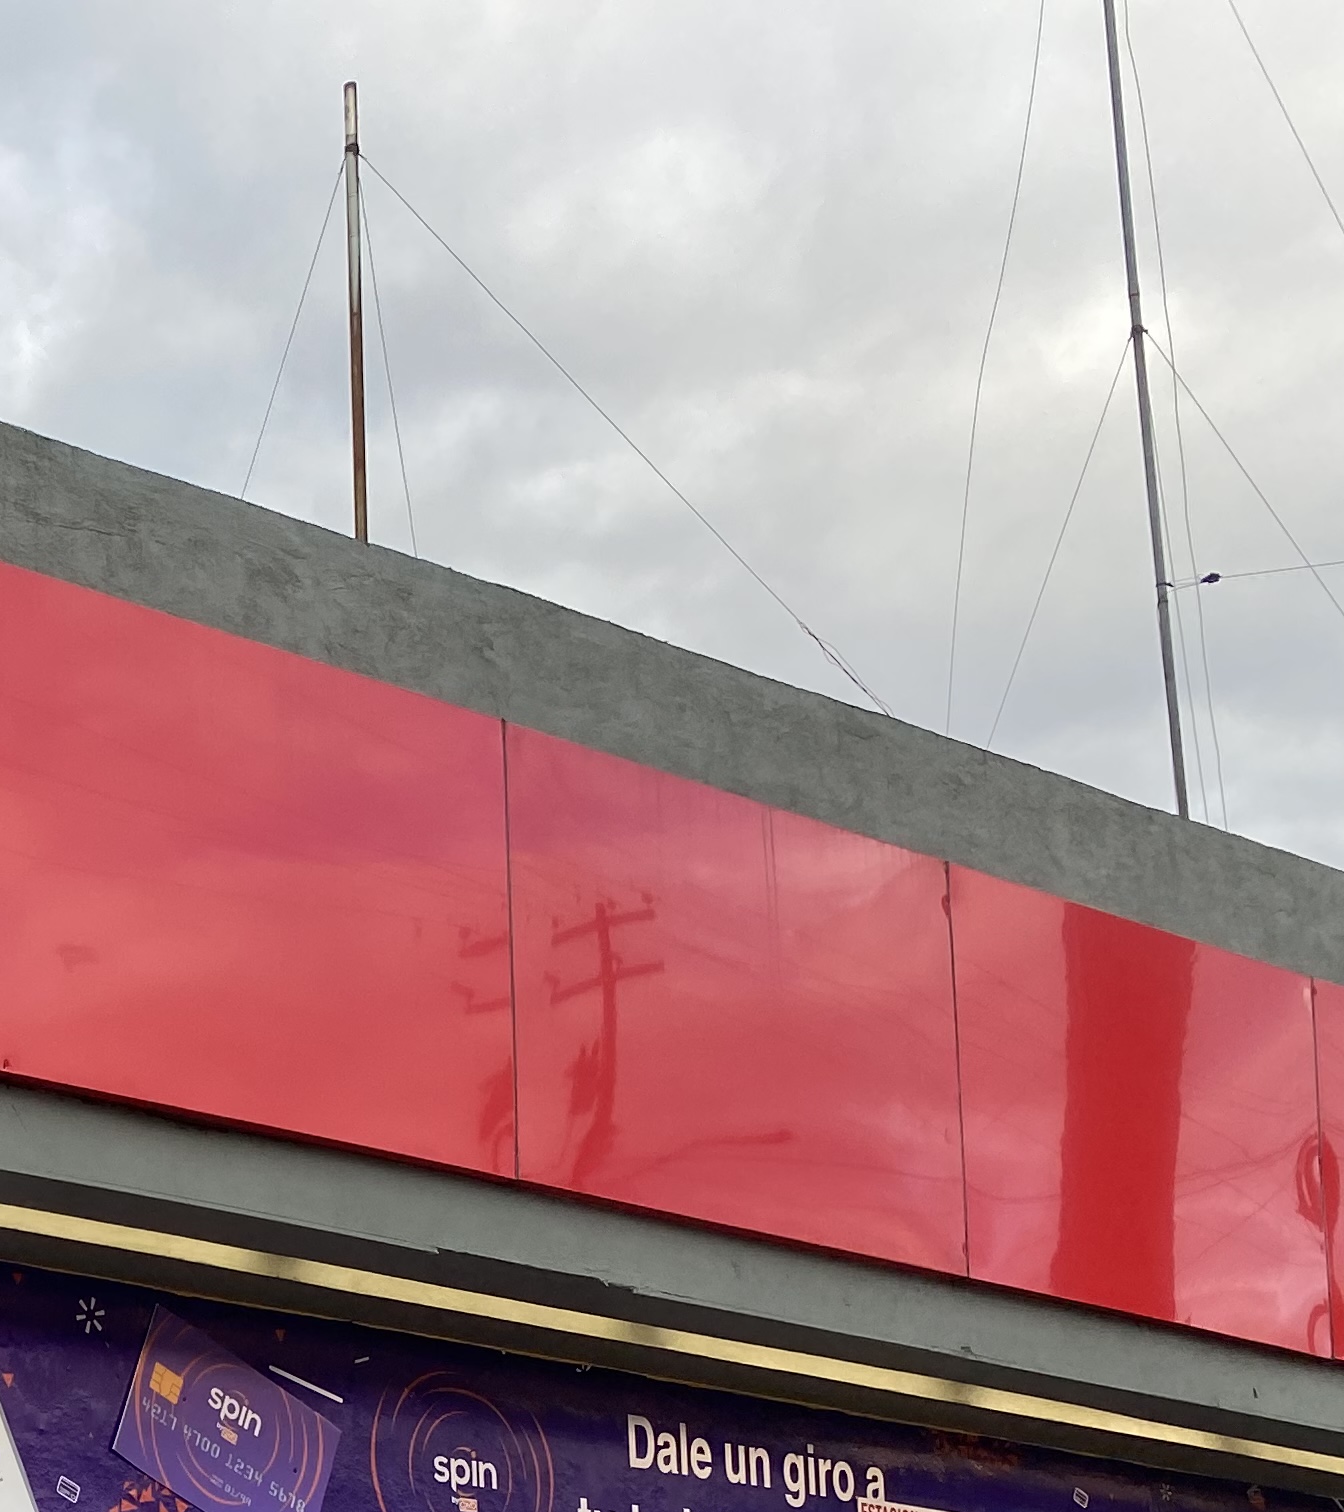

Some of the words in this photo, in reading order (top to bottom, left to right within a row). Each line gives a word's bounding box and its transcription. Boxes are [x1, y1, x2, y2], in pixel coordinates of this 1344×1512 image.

[207, 1387, 263, 1438] spin
[224, 1453, 263, 1487] 1234
[433, 1450, 498, 1493] spin
[626, 1413, 713, 1479] Dale
[723, 1442, 772, 1489] un
[782, 1443, 854, 1509] giro
[864, 1465, 887, 1501] a
